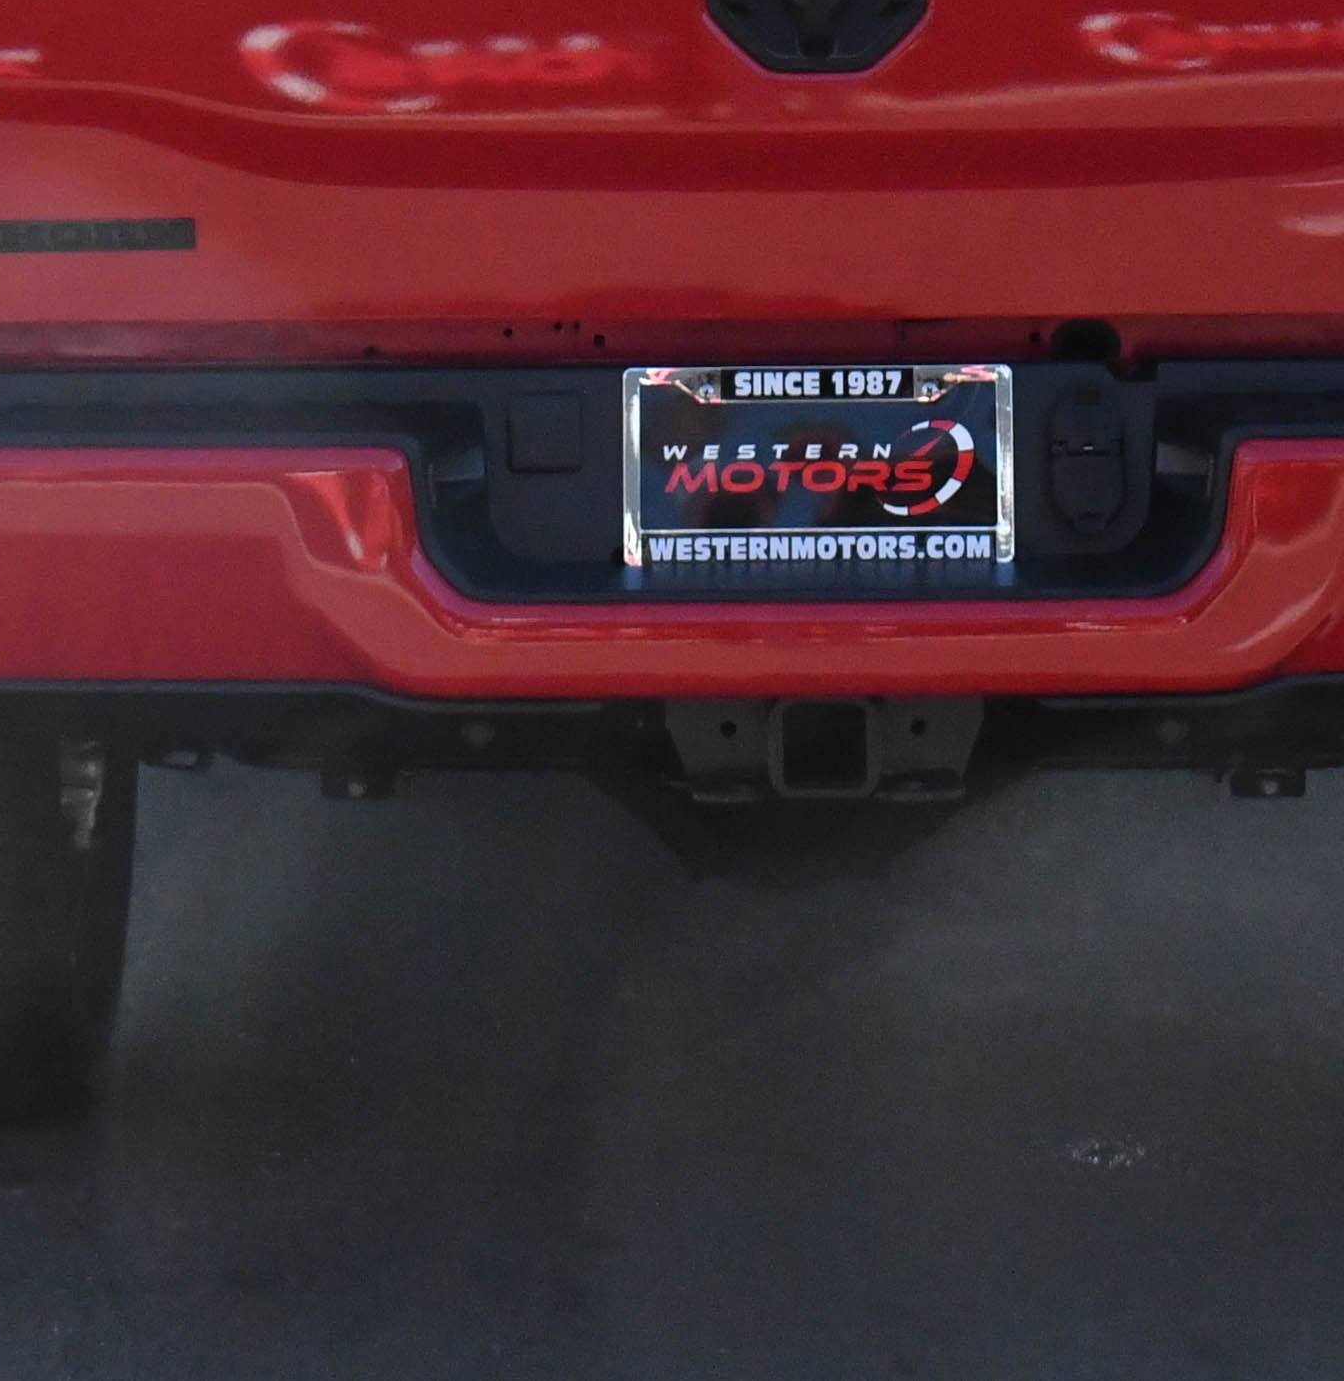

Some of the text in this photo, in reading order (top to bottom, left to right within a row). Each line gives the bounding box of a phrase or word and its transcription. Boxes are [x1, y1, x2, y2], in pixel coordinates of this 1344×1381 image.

[734, 370, 903, 397] SINCE 1987
[662, 443, 892, 461] WESTERN
[663, 460, 935, 494] MOTORS
[648, 534, 992, 562] WESTERNMOTORS.COM
